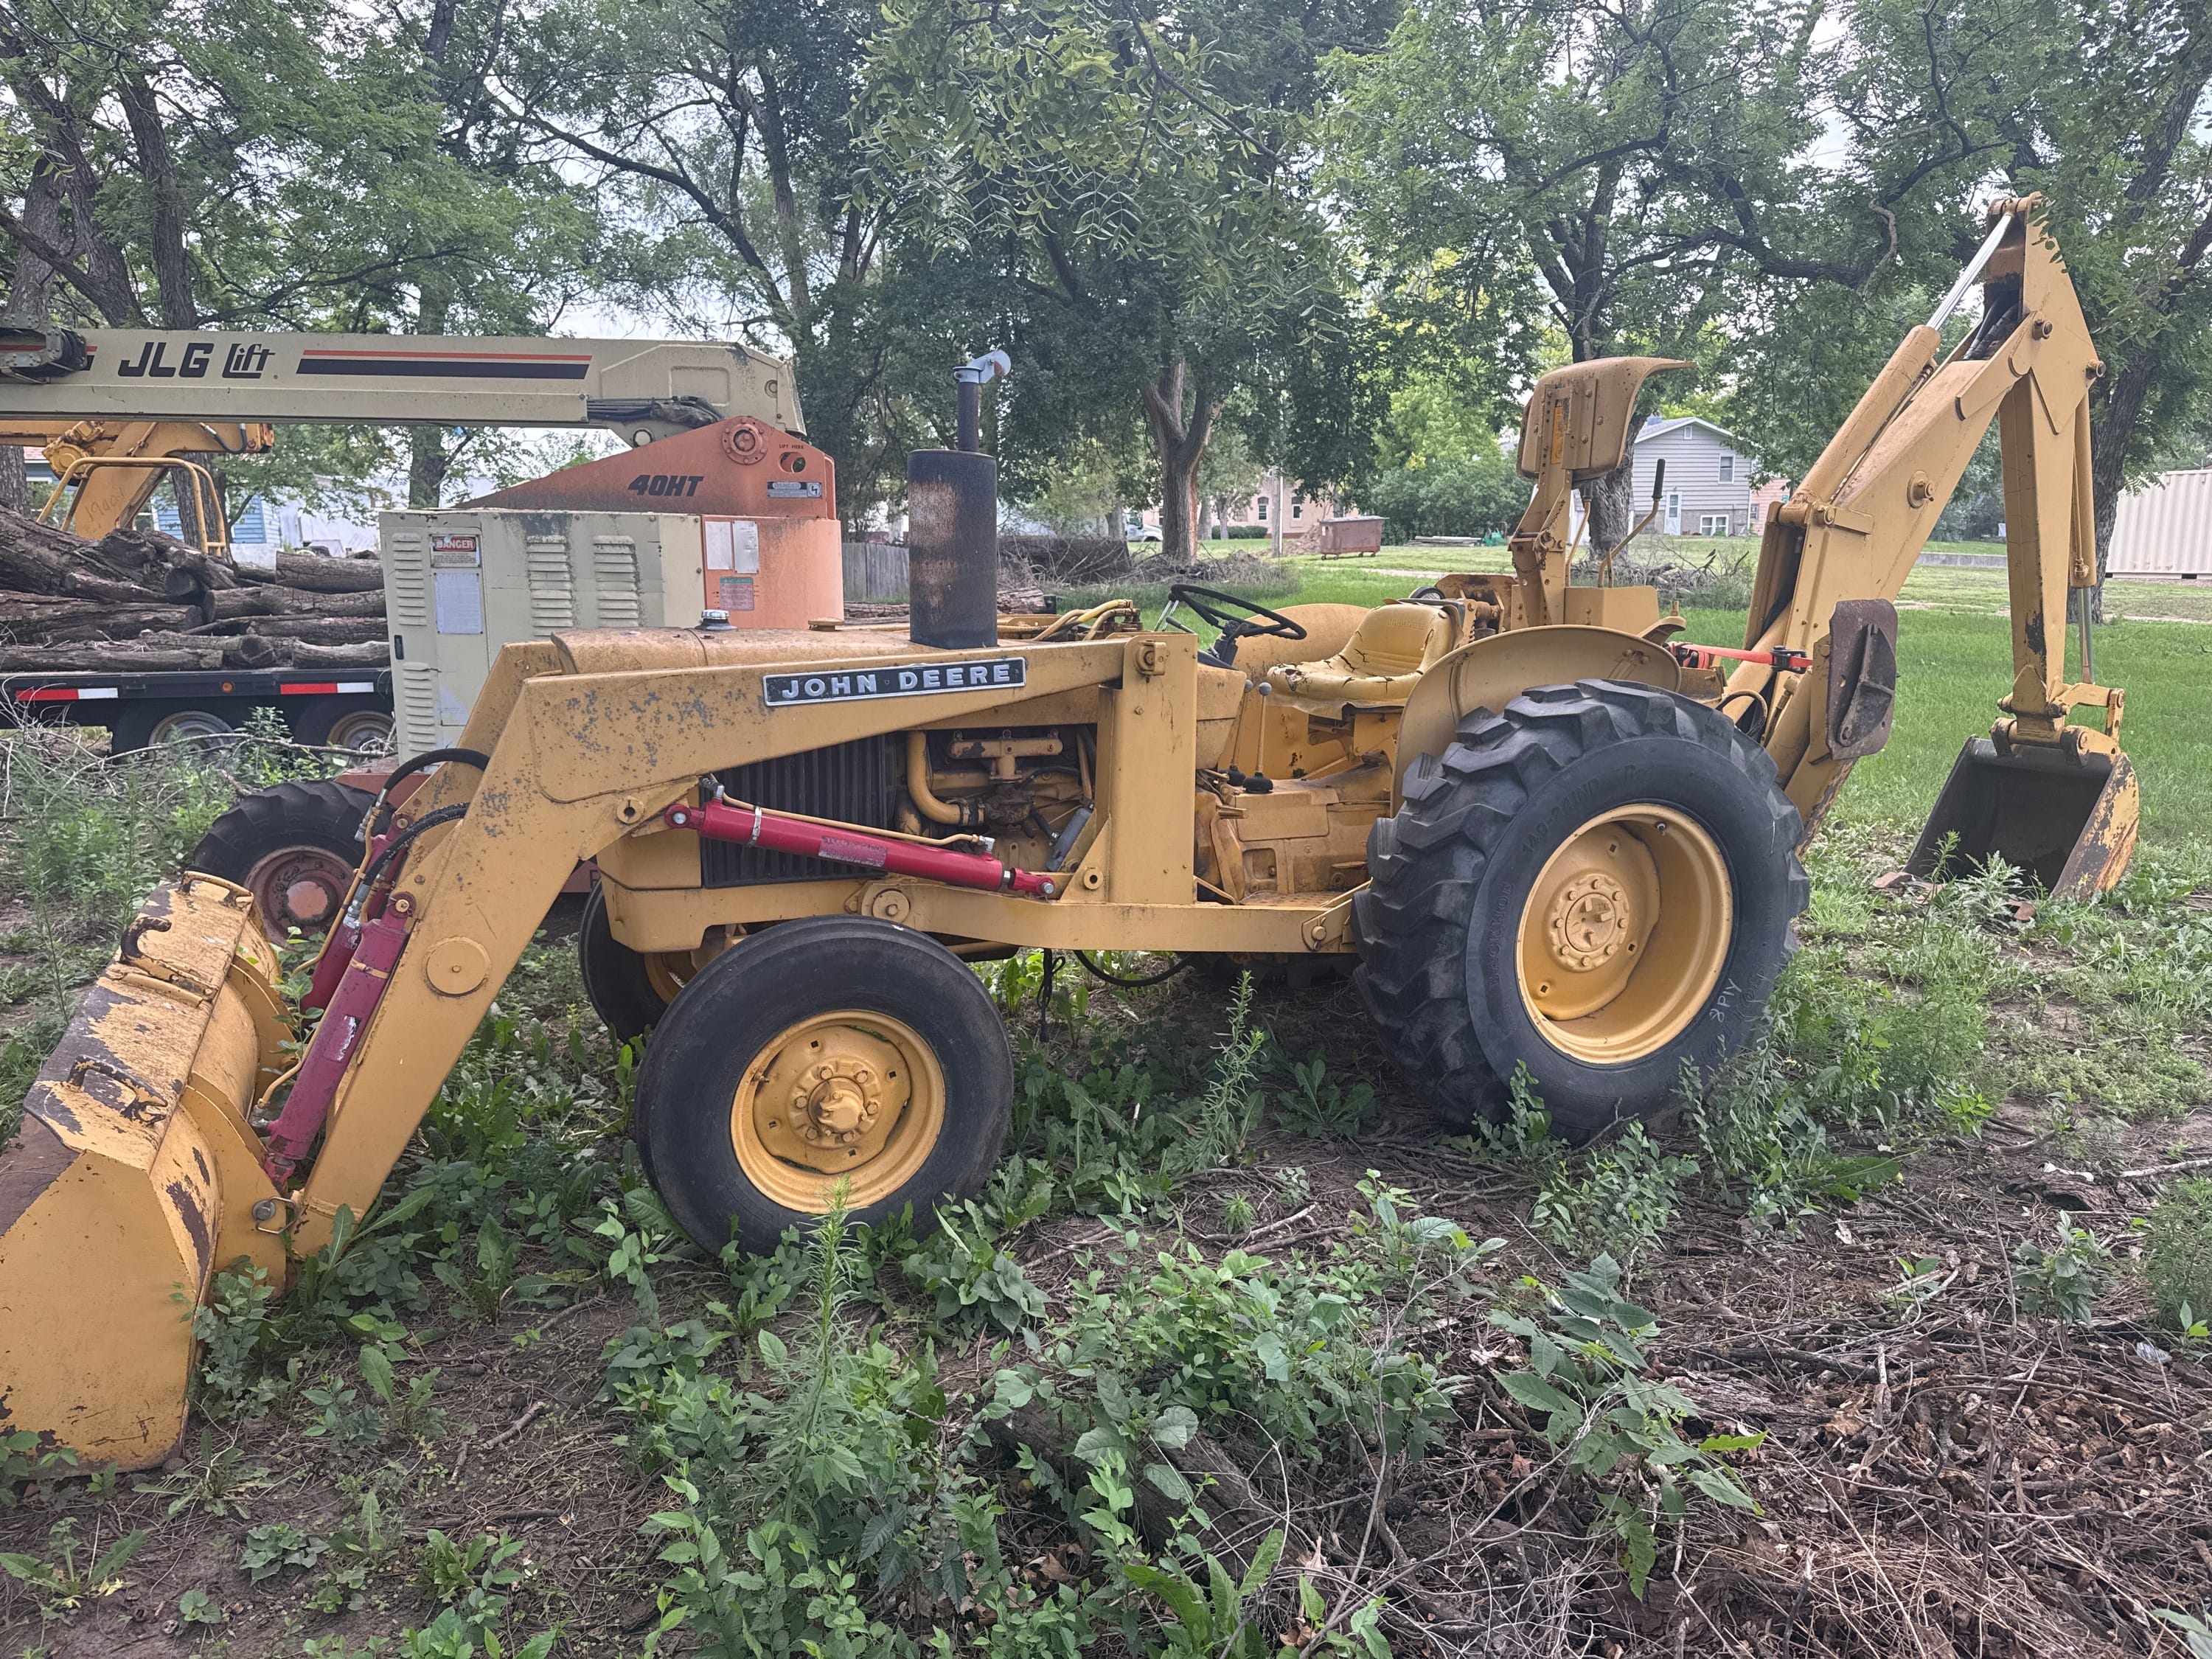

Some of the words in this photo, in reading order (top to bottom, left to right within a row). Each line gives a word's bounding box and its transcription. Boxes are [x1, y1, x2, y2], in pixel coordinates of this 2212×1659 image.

[117, 341, 215, 378] JLG
[221, 343, 276, 379] Lift
[627, 474, 705, 497] 40HT
[436, 539, 473, 549] DANGER
[782, 673, 877, 699] JOHN
[898, 664, 1010, 691] DEERE
